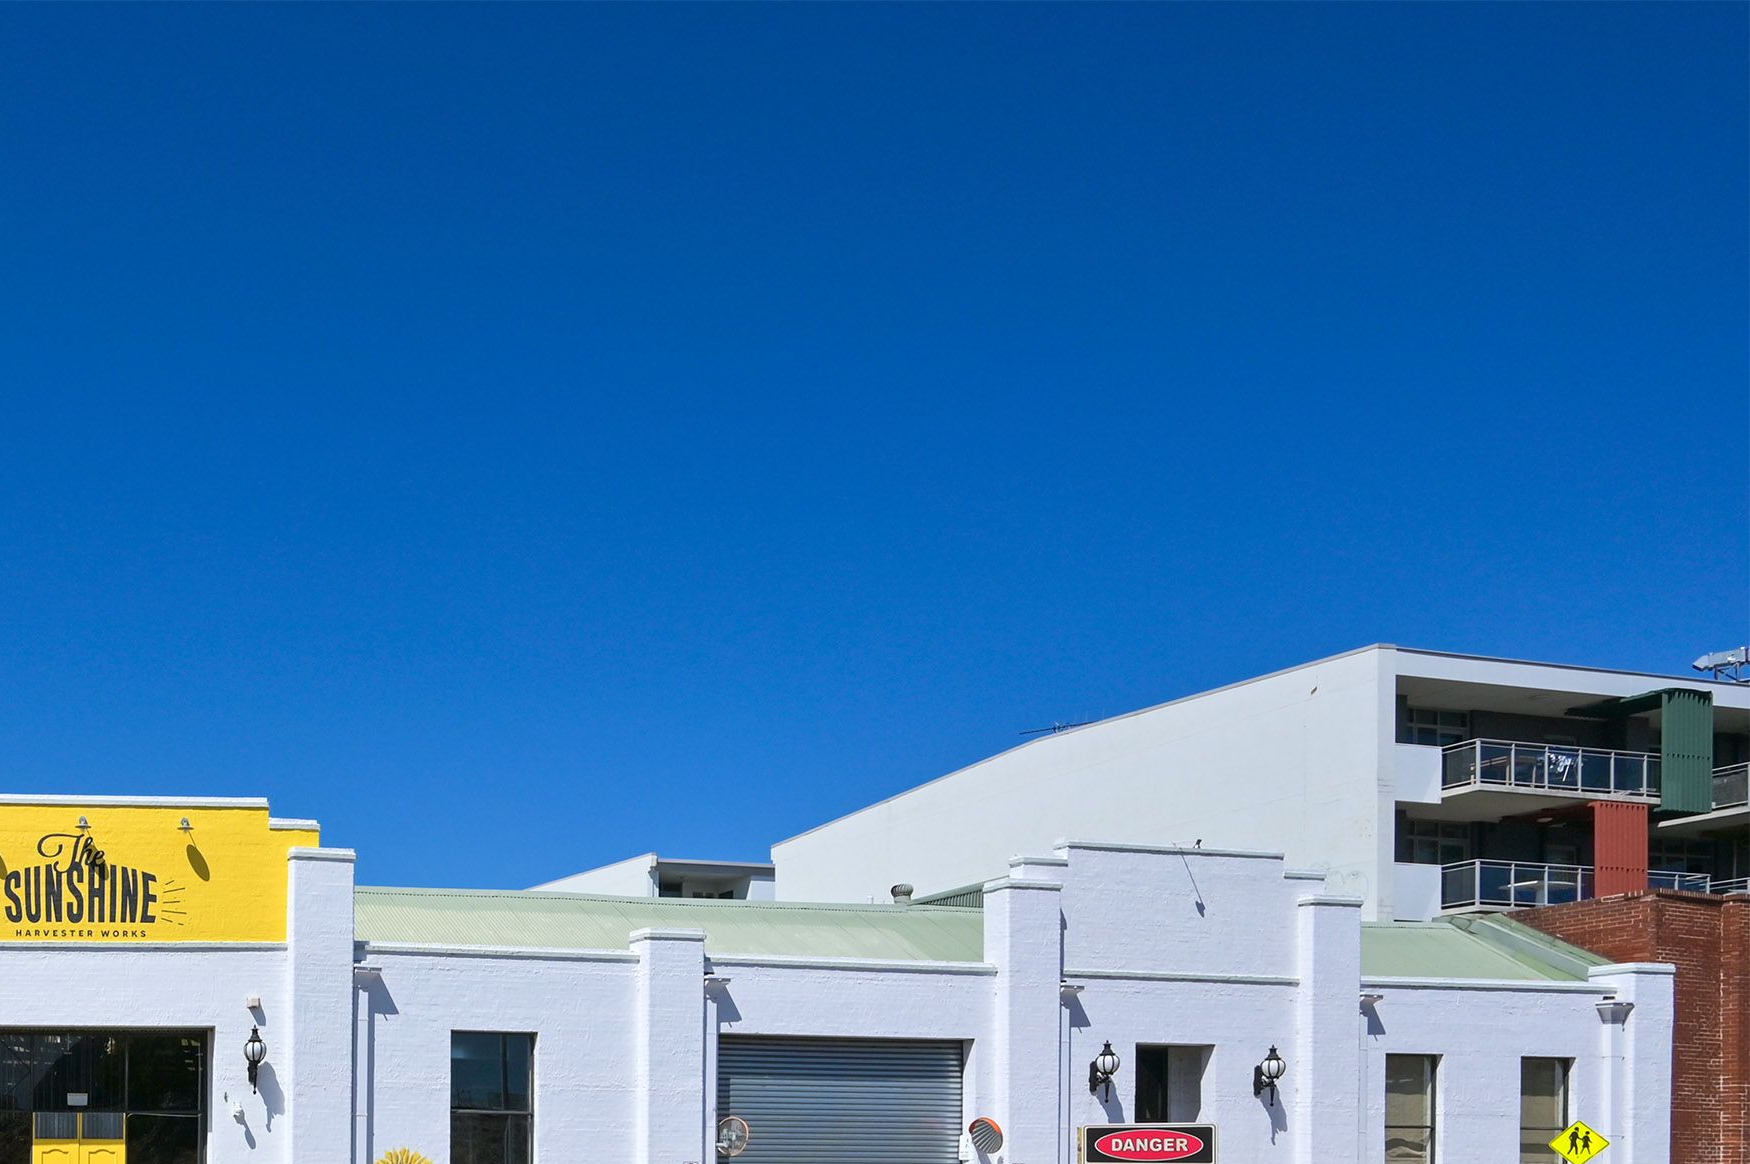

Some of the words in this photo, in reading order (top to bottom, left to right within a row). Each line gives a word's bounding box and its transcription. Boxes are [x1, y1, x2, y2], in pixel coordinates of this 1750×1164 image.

[37, 833, 105, 873] The
[4, 861, 158, 924] SUNSHINE
[16, 929, 93, 937] HARVESTER
[101, 930, 147, 938] WORKS
[1111, 1138, 1189, 1152] DANGER
